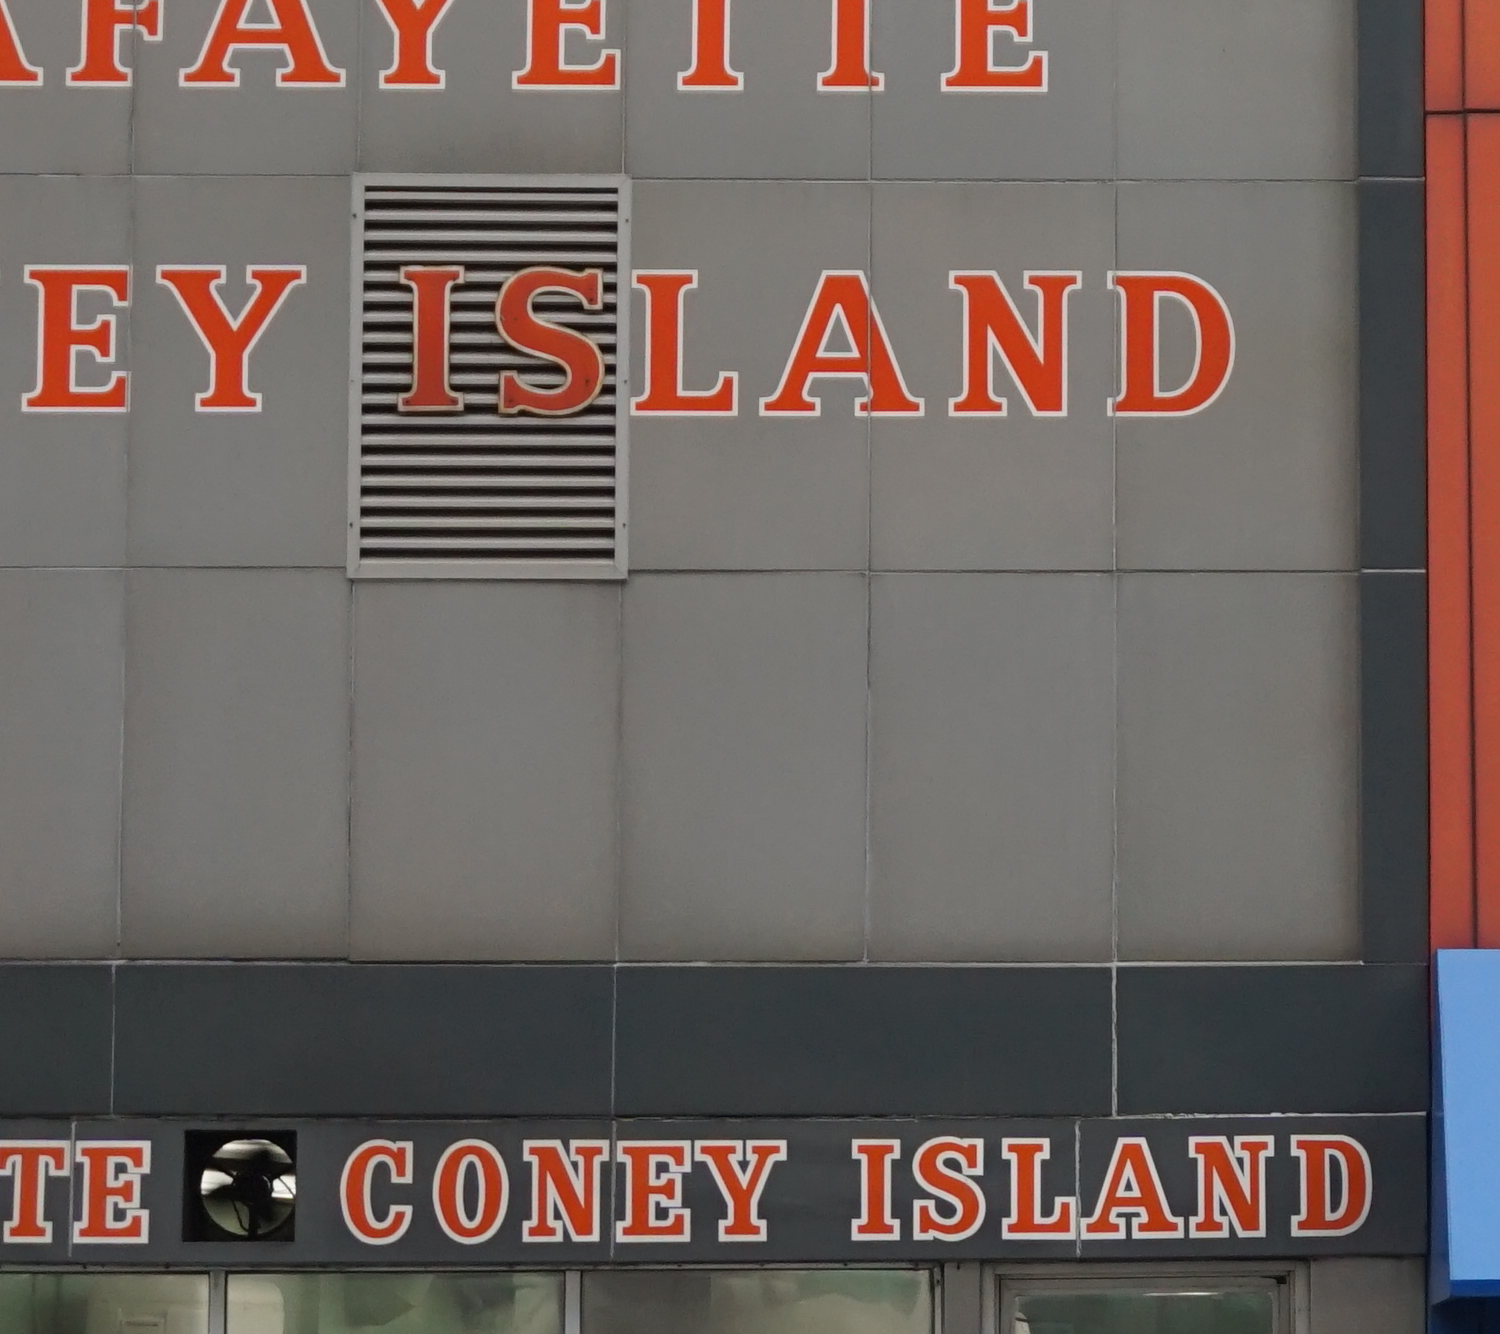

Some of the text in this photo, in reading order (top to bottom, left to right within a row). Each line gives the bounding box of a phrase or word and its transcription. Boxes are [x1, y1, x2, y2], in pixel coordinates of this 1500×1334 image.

[397, 264, 1237, 418] ISLAND
[340, 1138, 788, 1245] CONEY
[850, 1134, 1374, 1242] ISLAND
